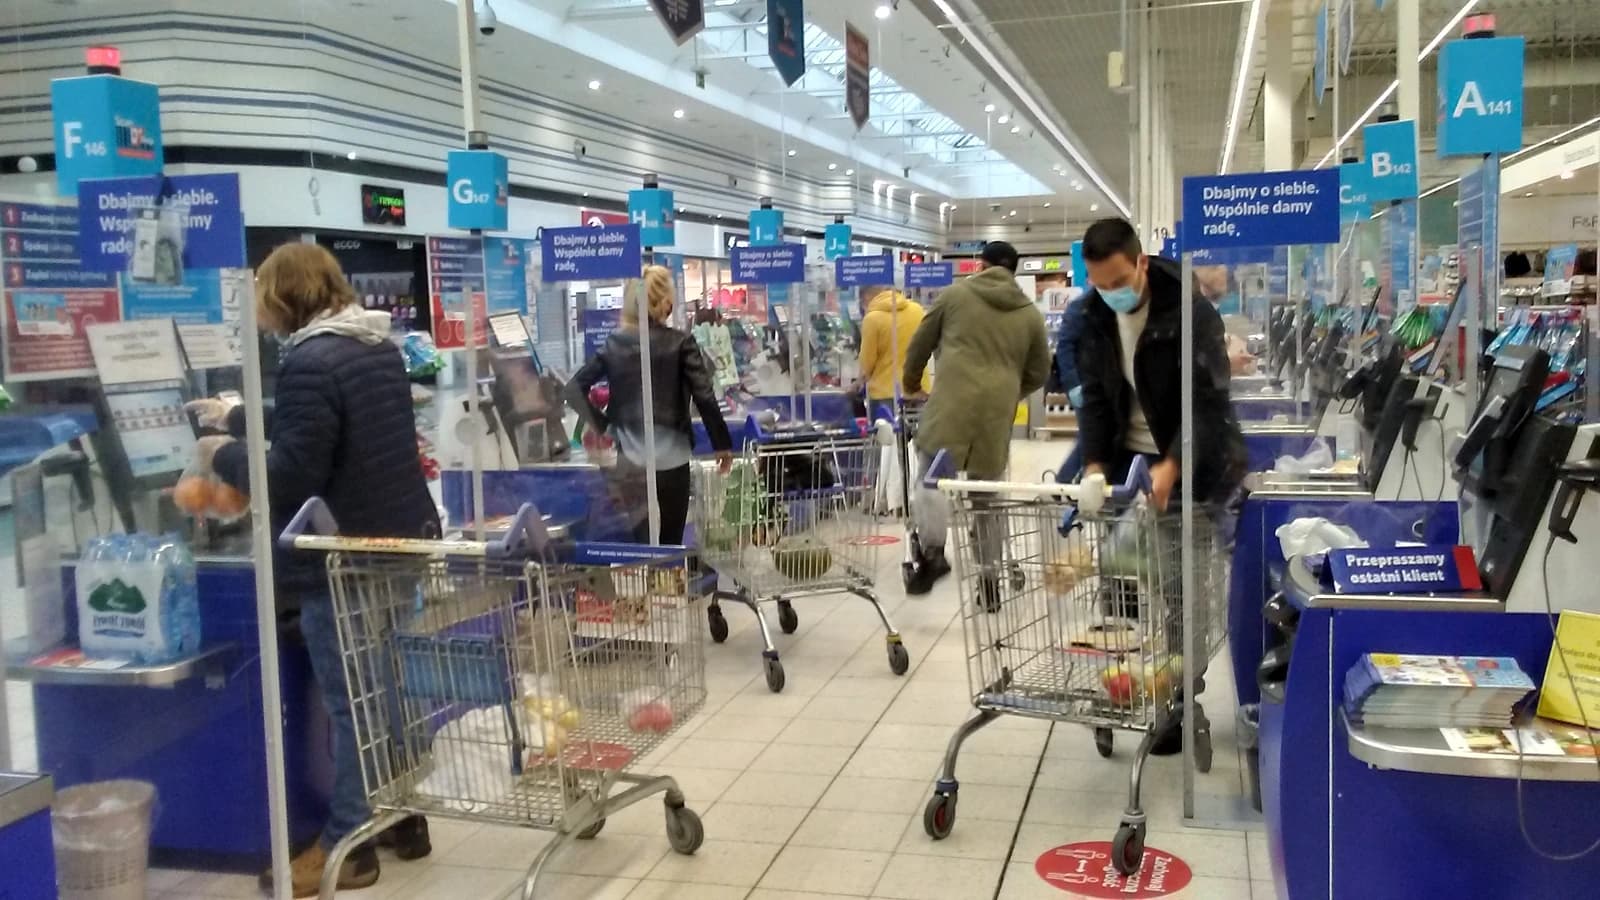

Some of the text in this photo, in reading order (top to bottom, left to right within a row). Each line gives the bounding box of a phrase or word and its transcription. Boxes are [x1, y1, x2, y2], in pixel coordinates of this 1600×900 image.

[1452, 81, 1512, 119] A 141
[63, 121, 83, 159] F
[1371, 151, 1412, 178] B 142
[453, 178, 473, 205] G
[1203, 185, 1257, 202] Dbajmy
[1260, 186, 1270, 197] o
[1338, 184, 1353, 204] C
[632, 209, 647, 229] H
[1203, 200, 1313, 219] Wspólnie damy
[553, 234, 588, 247] Dbajmy
[590, 235, 597, 244] o
[554, 246, 624, 259] Wspólnie damy
[1345, 554, 1445, 568] Przepraszamy
[1350, 569, 1445, 583] ostatni klient
[1144, 856, 1172, 892] Zachowaj
